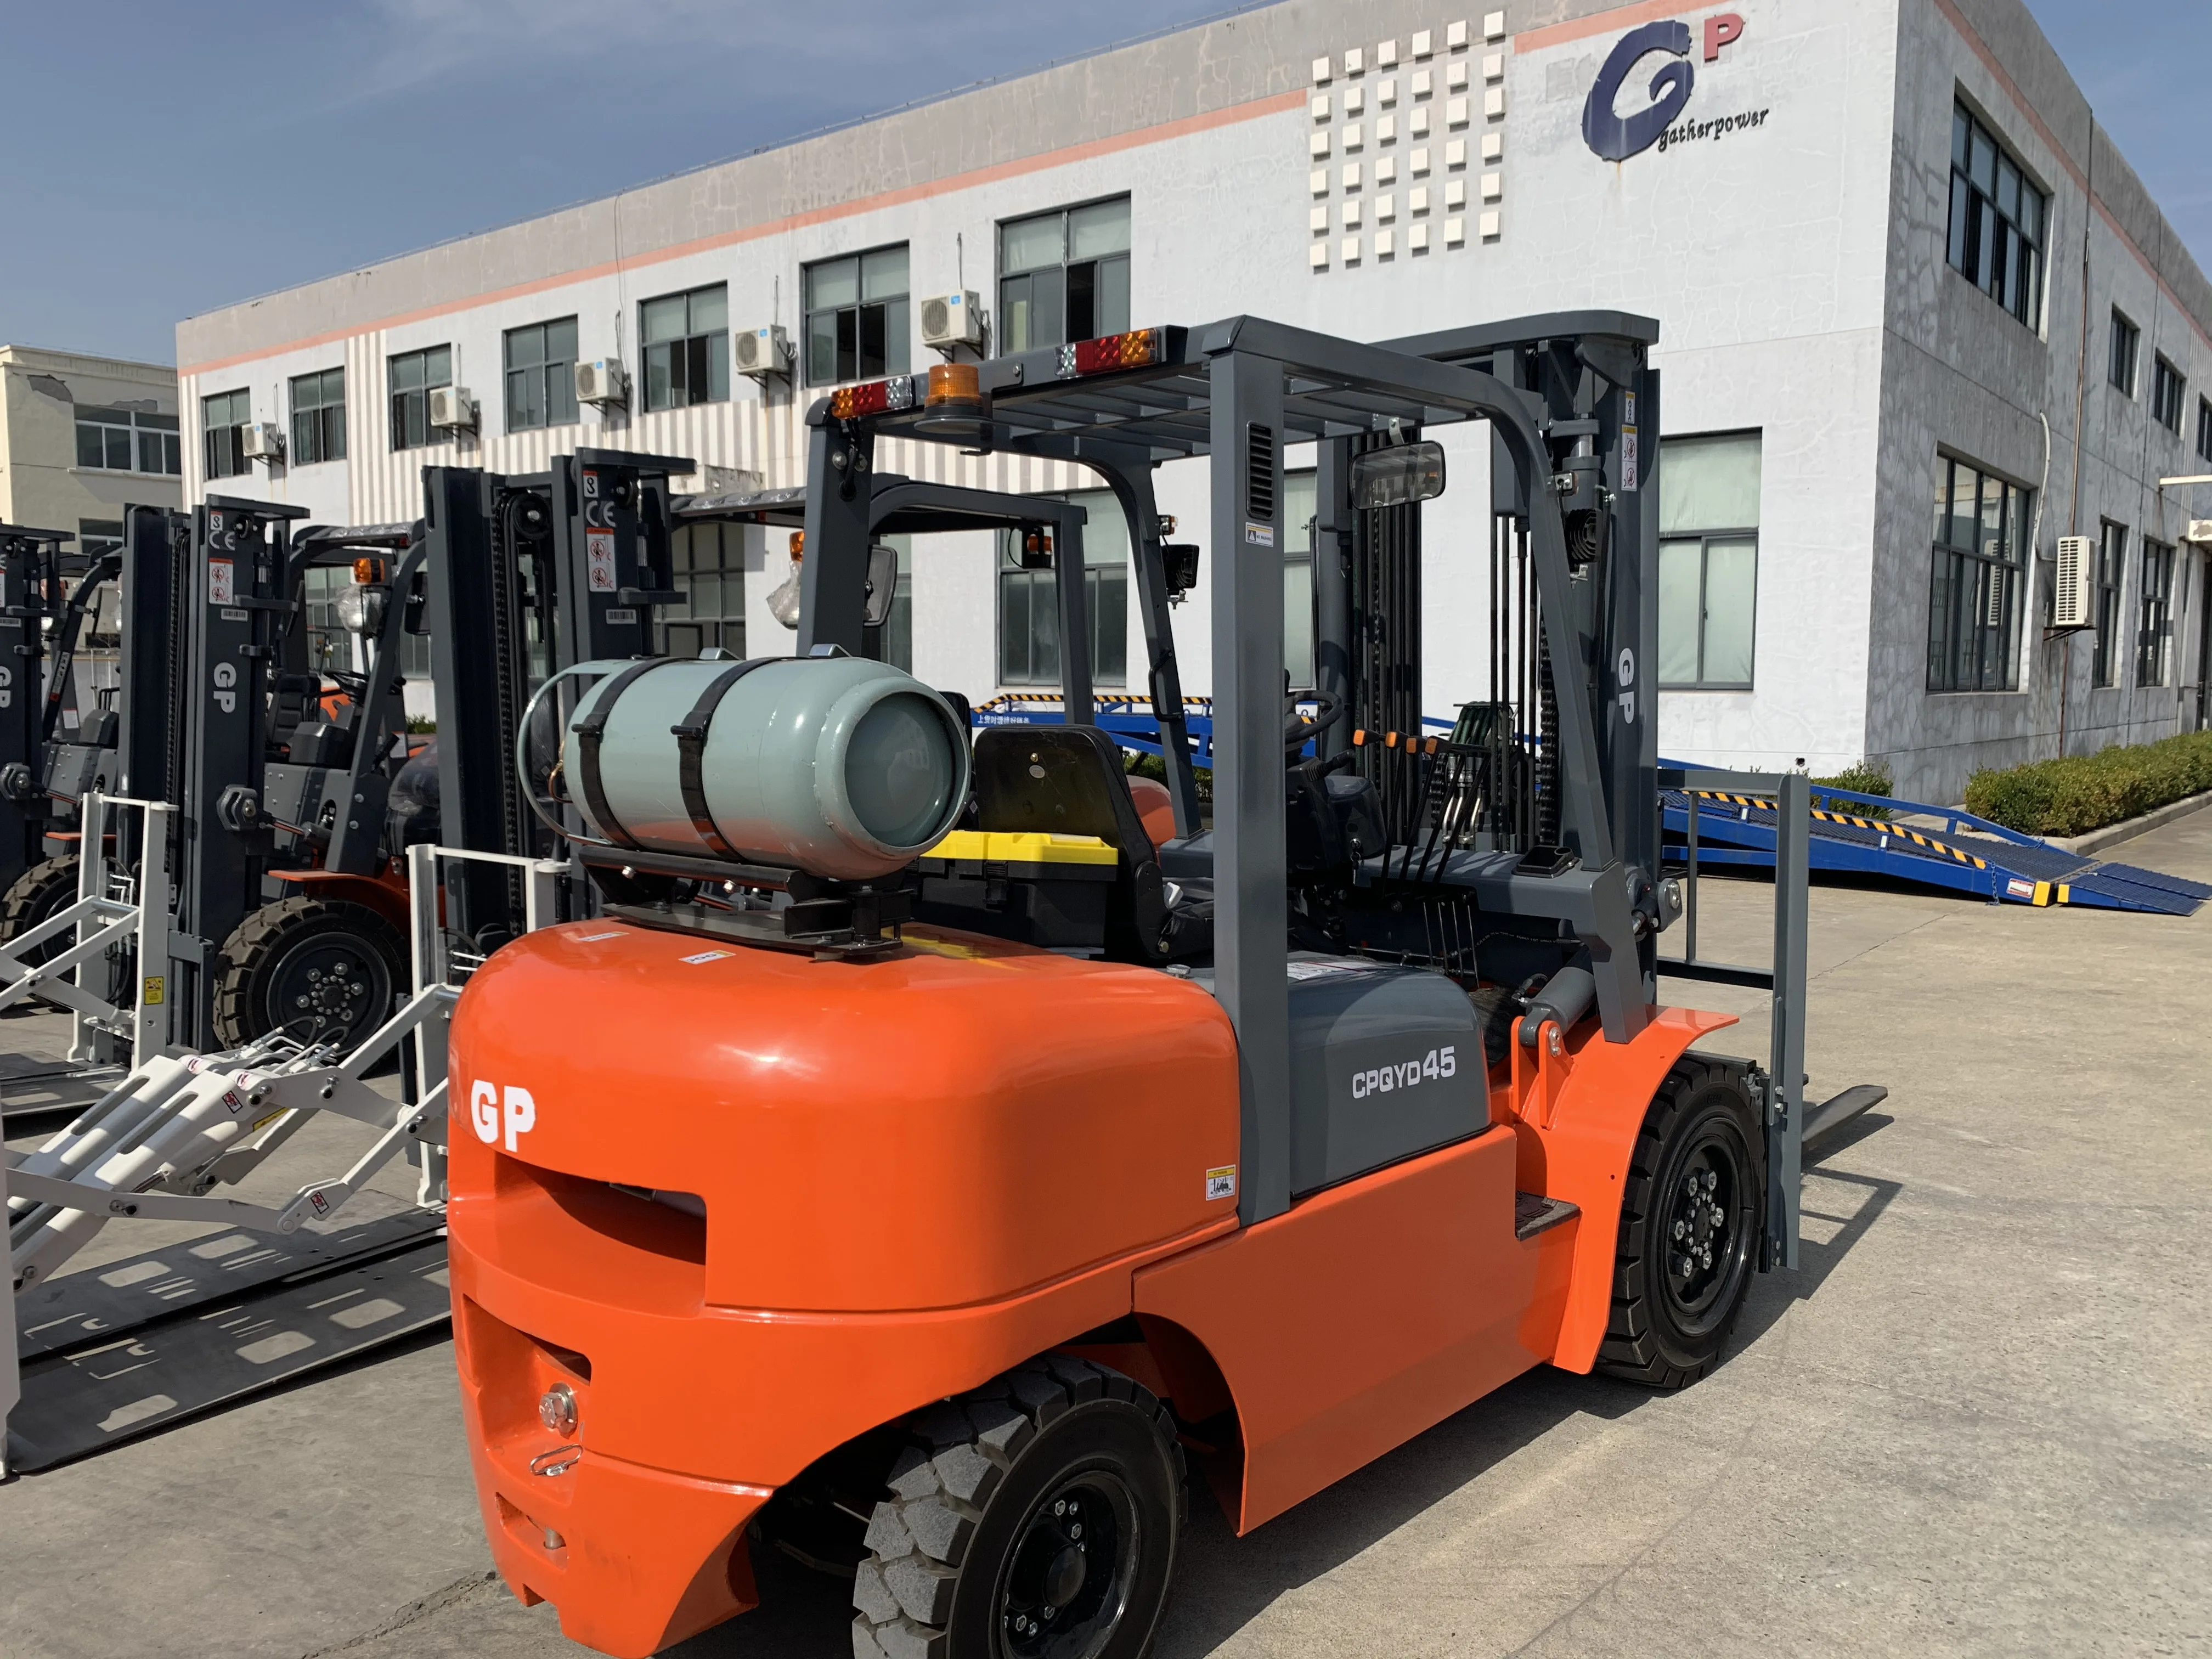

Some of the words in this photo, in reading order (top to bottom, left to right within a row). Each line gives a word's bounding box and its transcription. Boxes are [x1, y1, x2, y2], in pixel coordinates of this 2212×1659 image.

[1658, 108, 1769, 153] gatherpower
[585, 500, 616, 527] CE
[209, 531, 235, 551] CE
[213, 662, 236, 713] GP
[1618, 647, 1635, 724] GP
[1352, 1046, 1455, 1099] CPQYD45
[471, 1079, 537, 1153] GP
